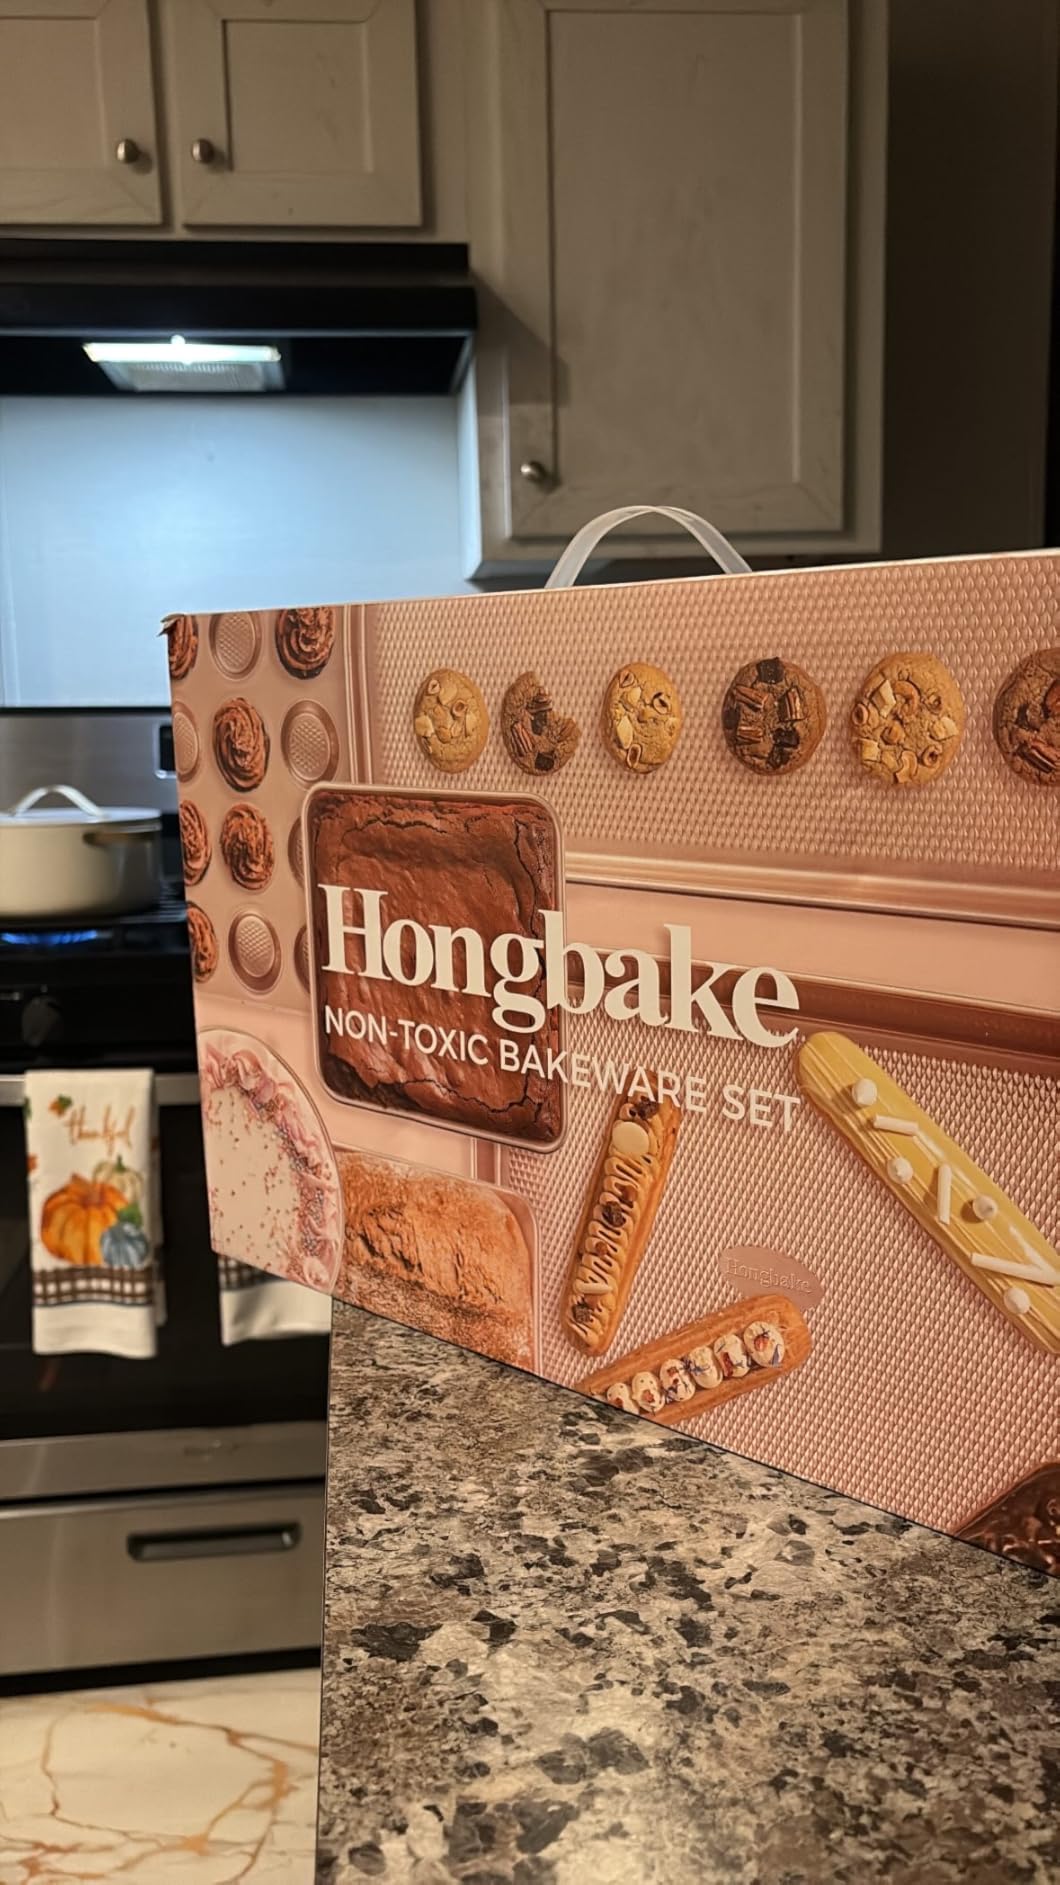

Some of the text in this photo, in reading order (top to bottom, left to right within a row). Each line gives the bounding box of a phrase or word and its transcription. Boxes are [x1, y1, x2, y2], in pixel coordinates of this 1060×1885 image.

[317, 883, 800, 1048] Hongbake
[325, 1005, 801, 1132] NON-TOXIC BAKEWARE SET
[725, 1257, 813, 1293] Hongbake
